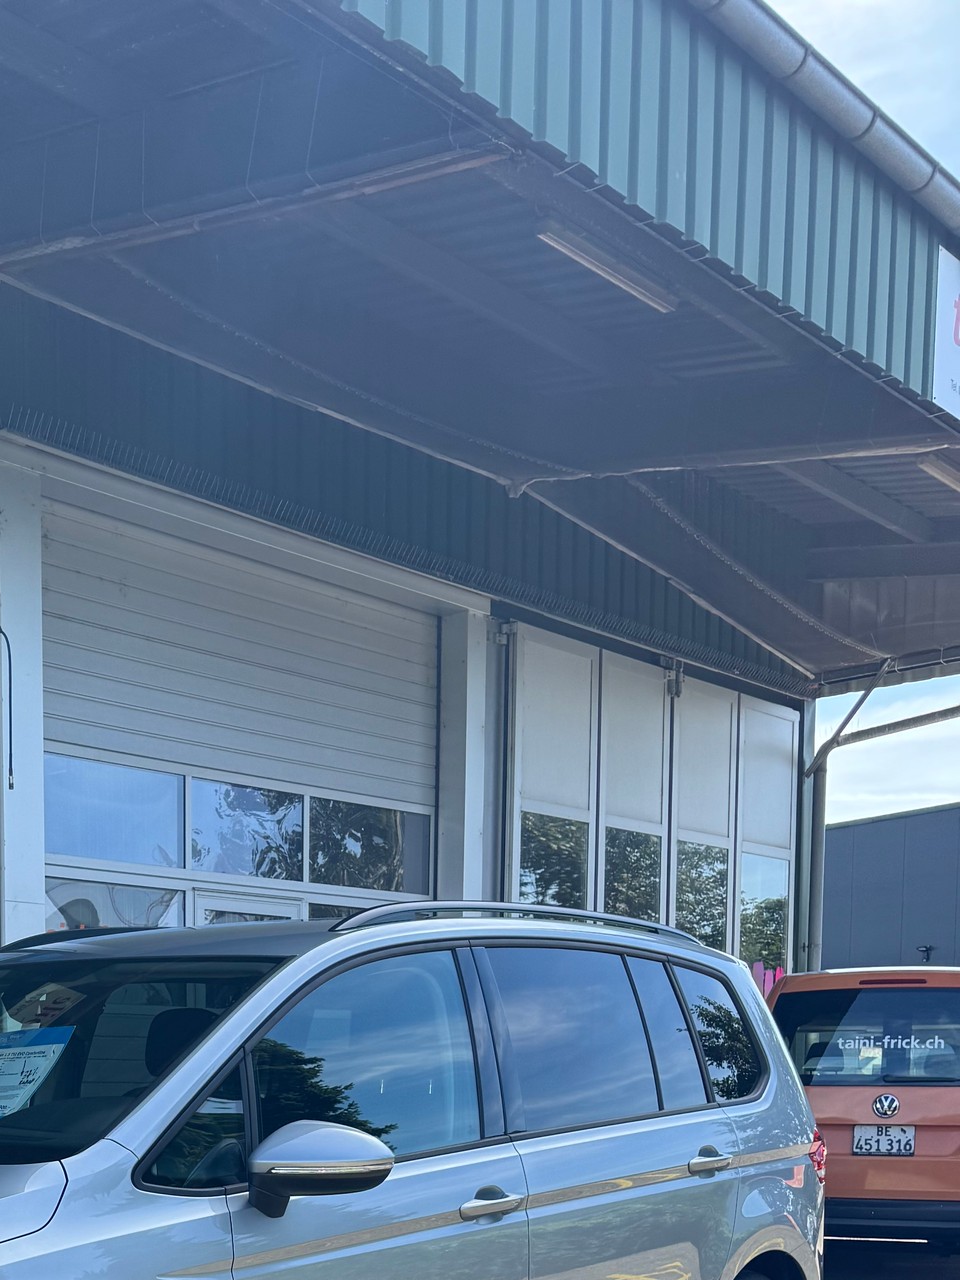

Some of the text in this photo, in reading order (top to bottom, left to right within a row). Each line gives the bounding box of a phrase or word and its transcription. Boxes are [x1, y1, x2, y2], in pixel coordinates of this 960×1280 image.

[876, 1126, 892, 1137] BE
[855, 1138, 913, 1151] 451 316
